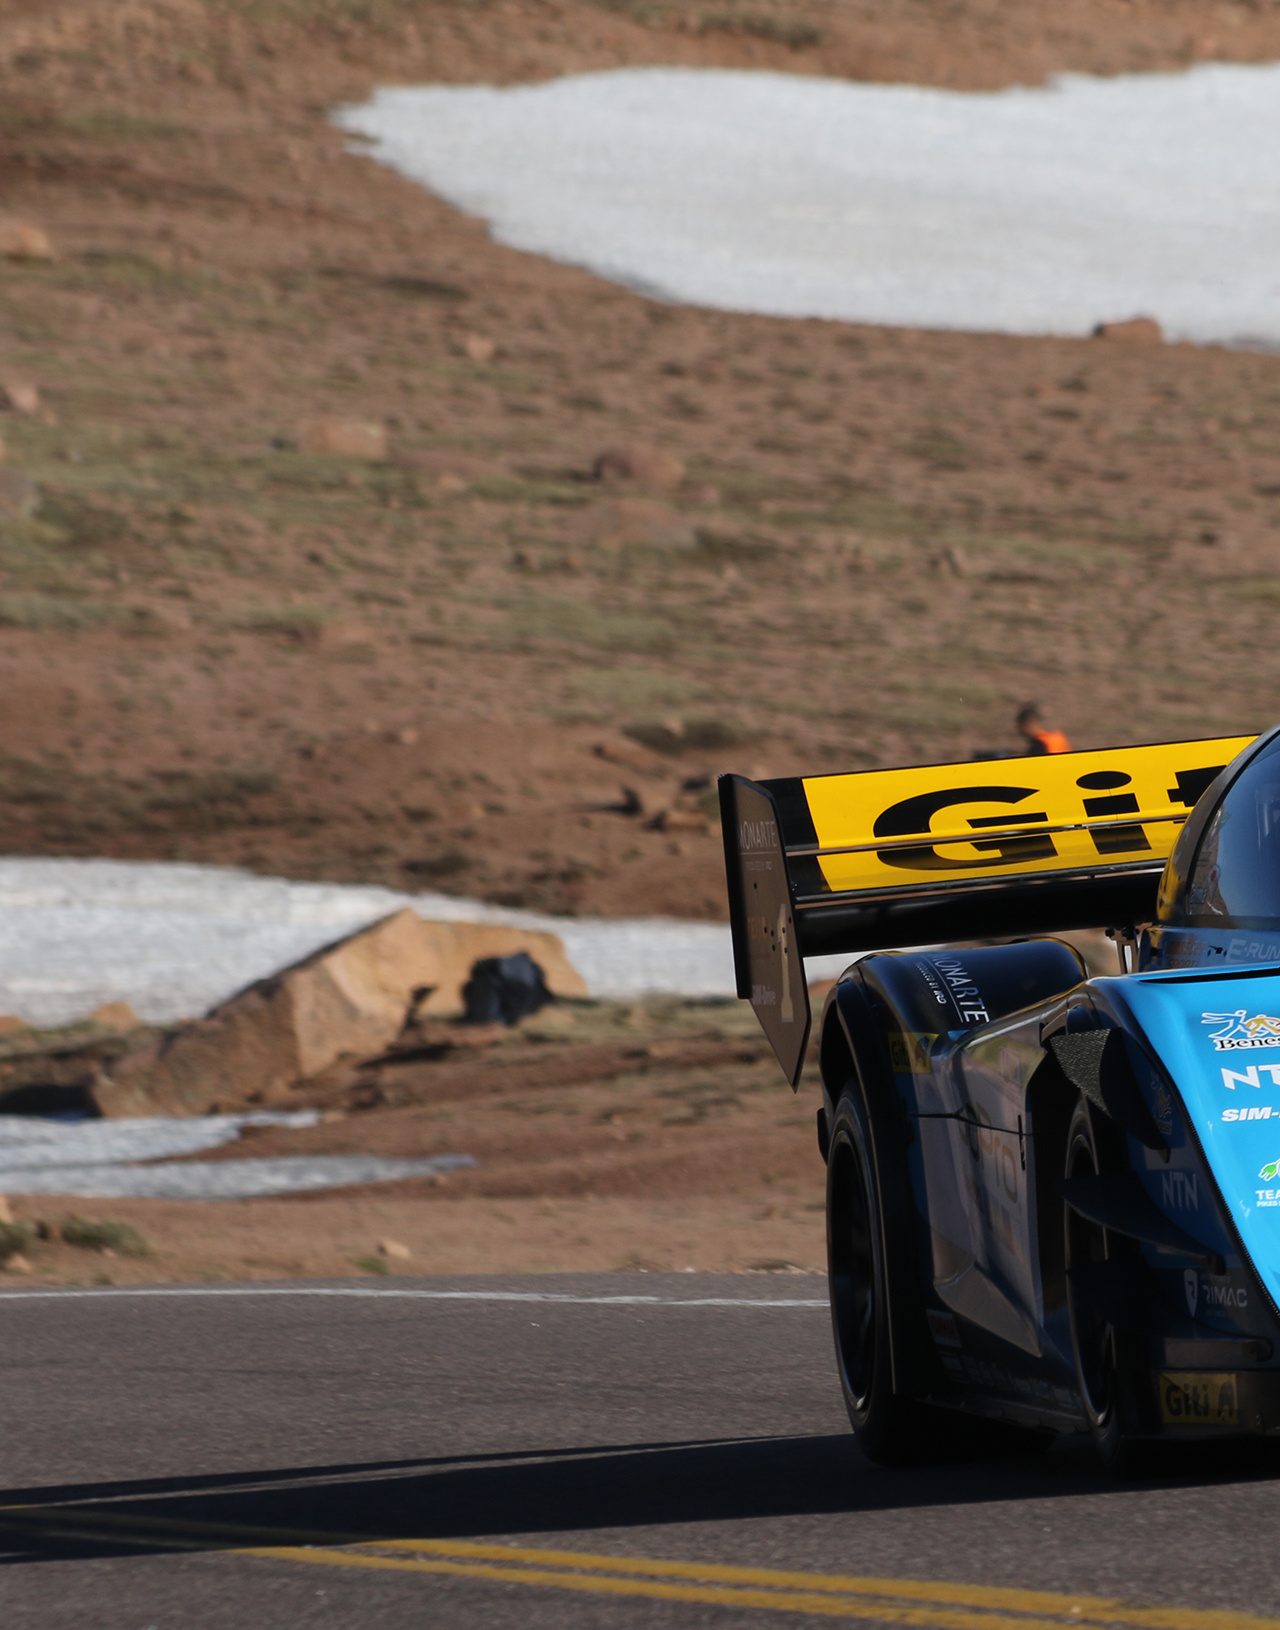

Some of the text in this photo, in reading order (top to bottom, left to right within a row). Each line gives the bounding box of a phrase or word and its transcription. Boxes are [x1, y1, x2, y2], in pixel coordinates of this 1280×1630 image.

[873, 765, 1228, 871] Git
[1162, 1170, 1198, 1212] NTN
[1165, 1382, 1210, 1417] Giti
